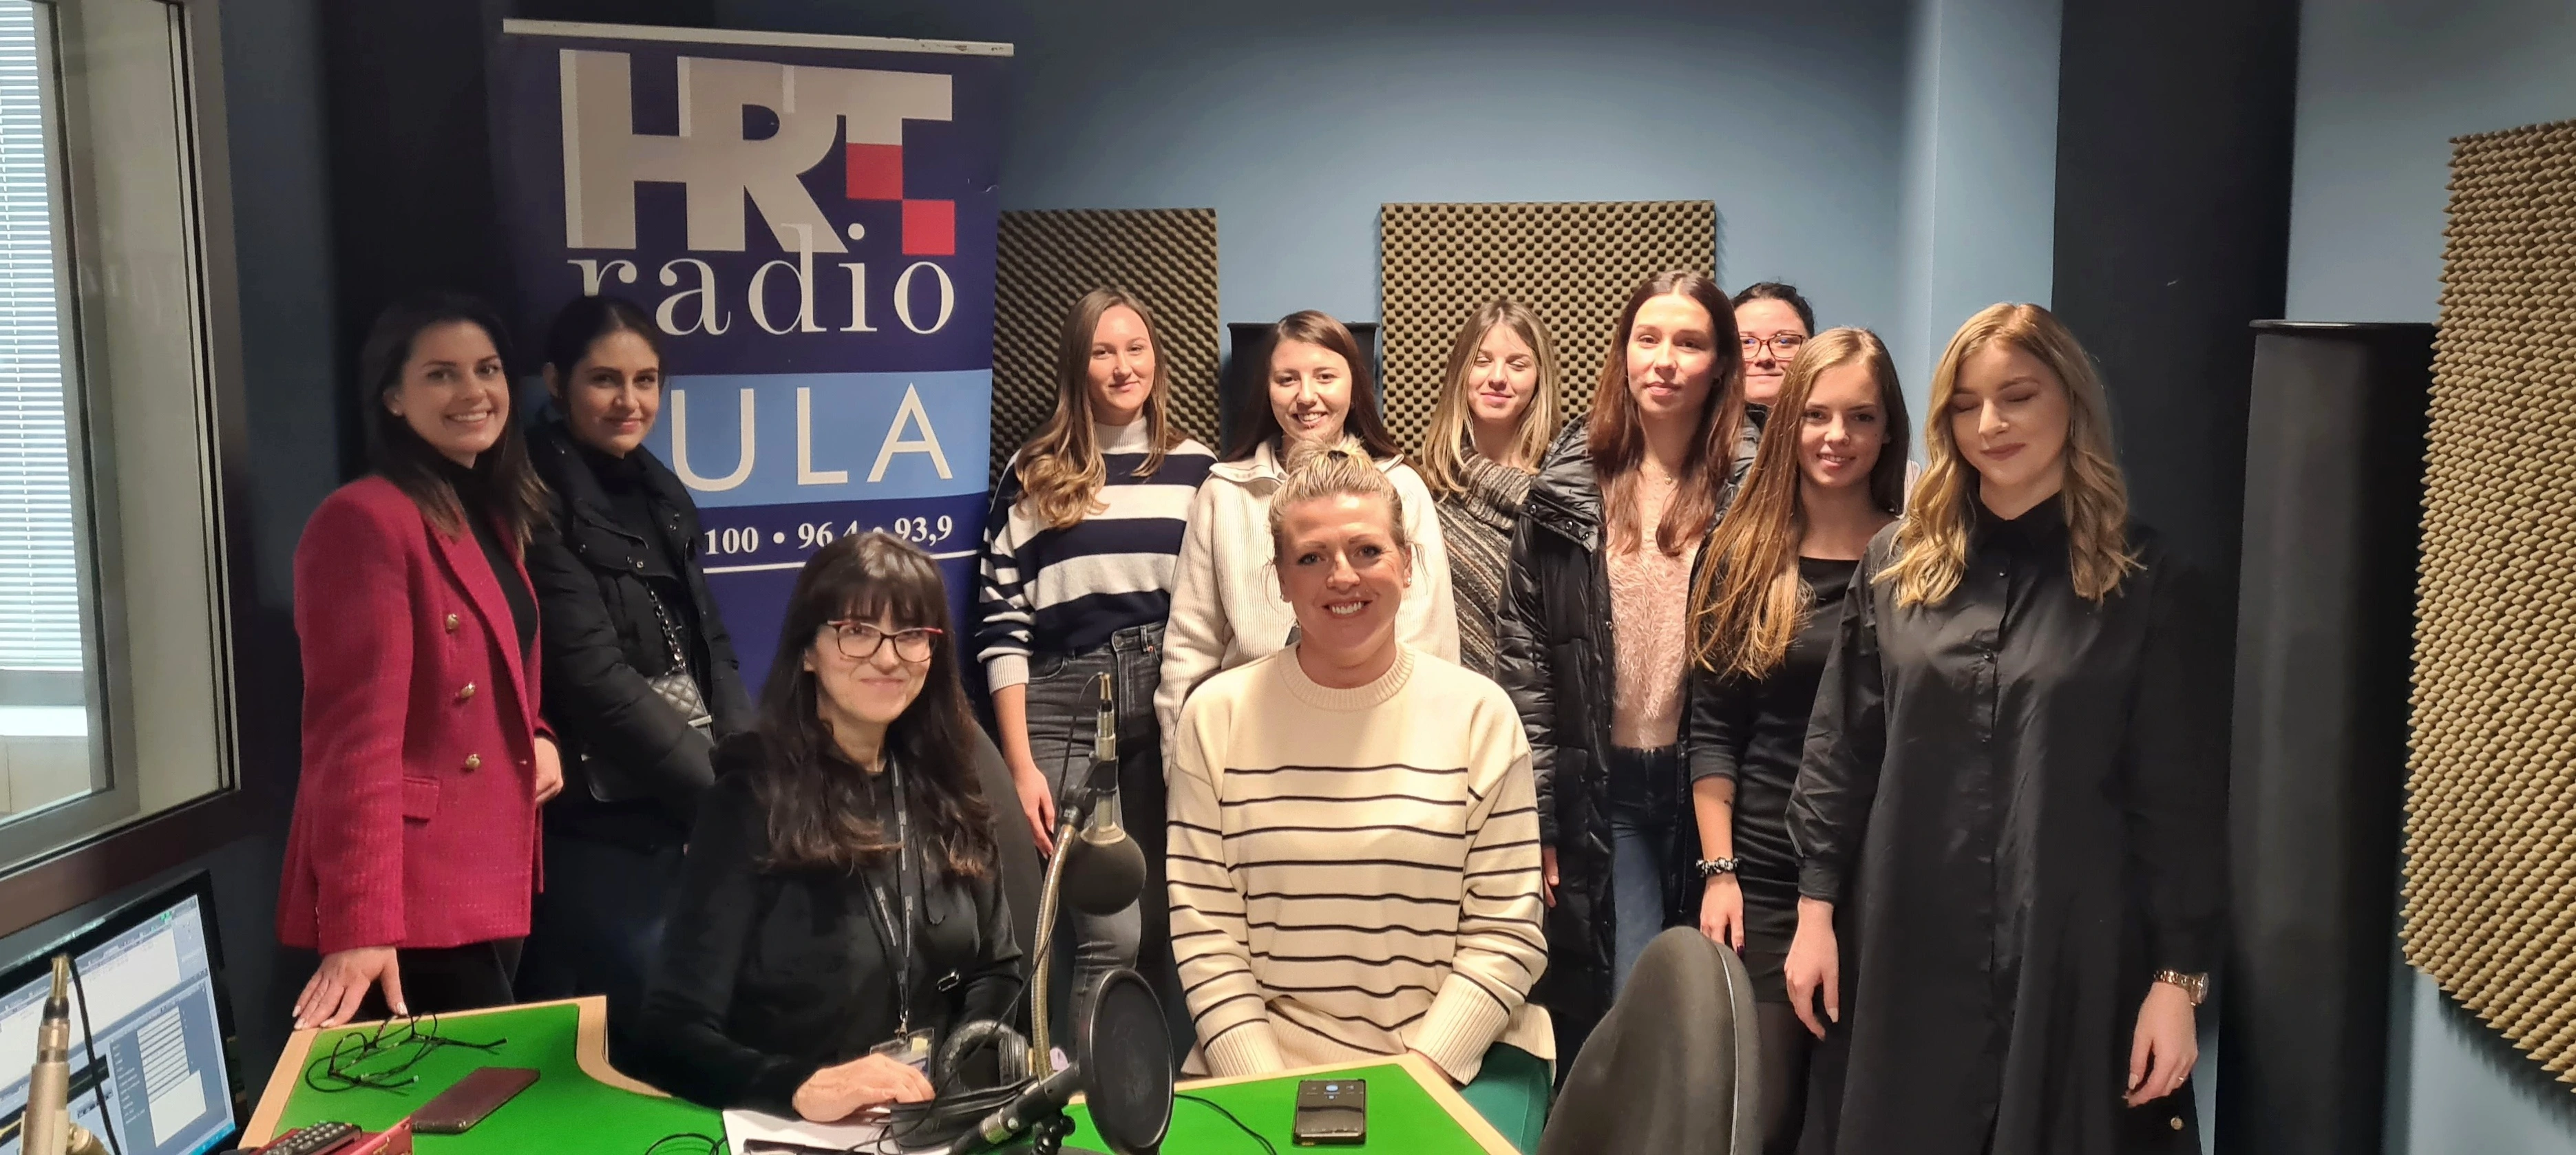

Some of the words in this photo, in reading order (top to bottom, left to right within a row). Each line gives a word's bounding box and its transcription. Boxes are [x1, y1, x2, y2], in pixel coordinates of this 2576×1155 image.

[560, 48, 956, 255] HRT
[567, 223, 956, 335] radio
[671, 382, 953, 492] ULA
[704, 527, 759, 555] 100
[797, 520, 858, 550] 964
[895, 514, 953, 547] 93,9
